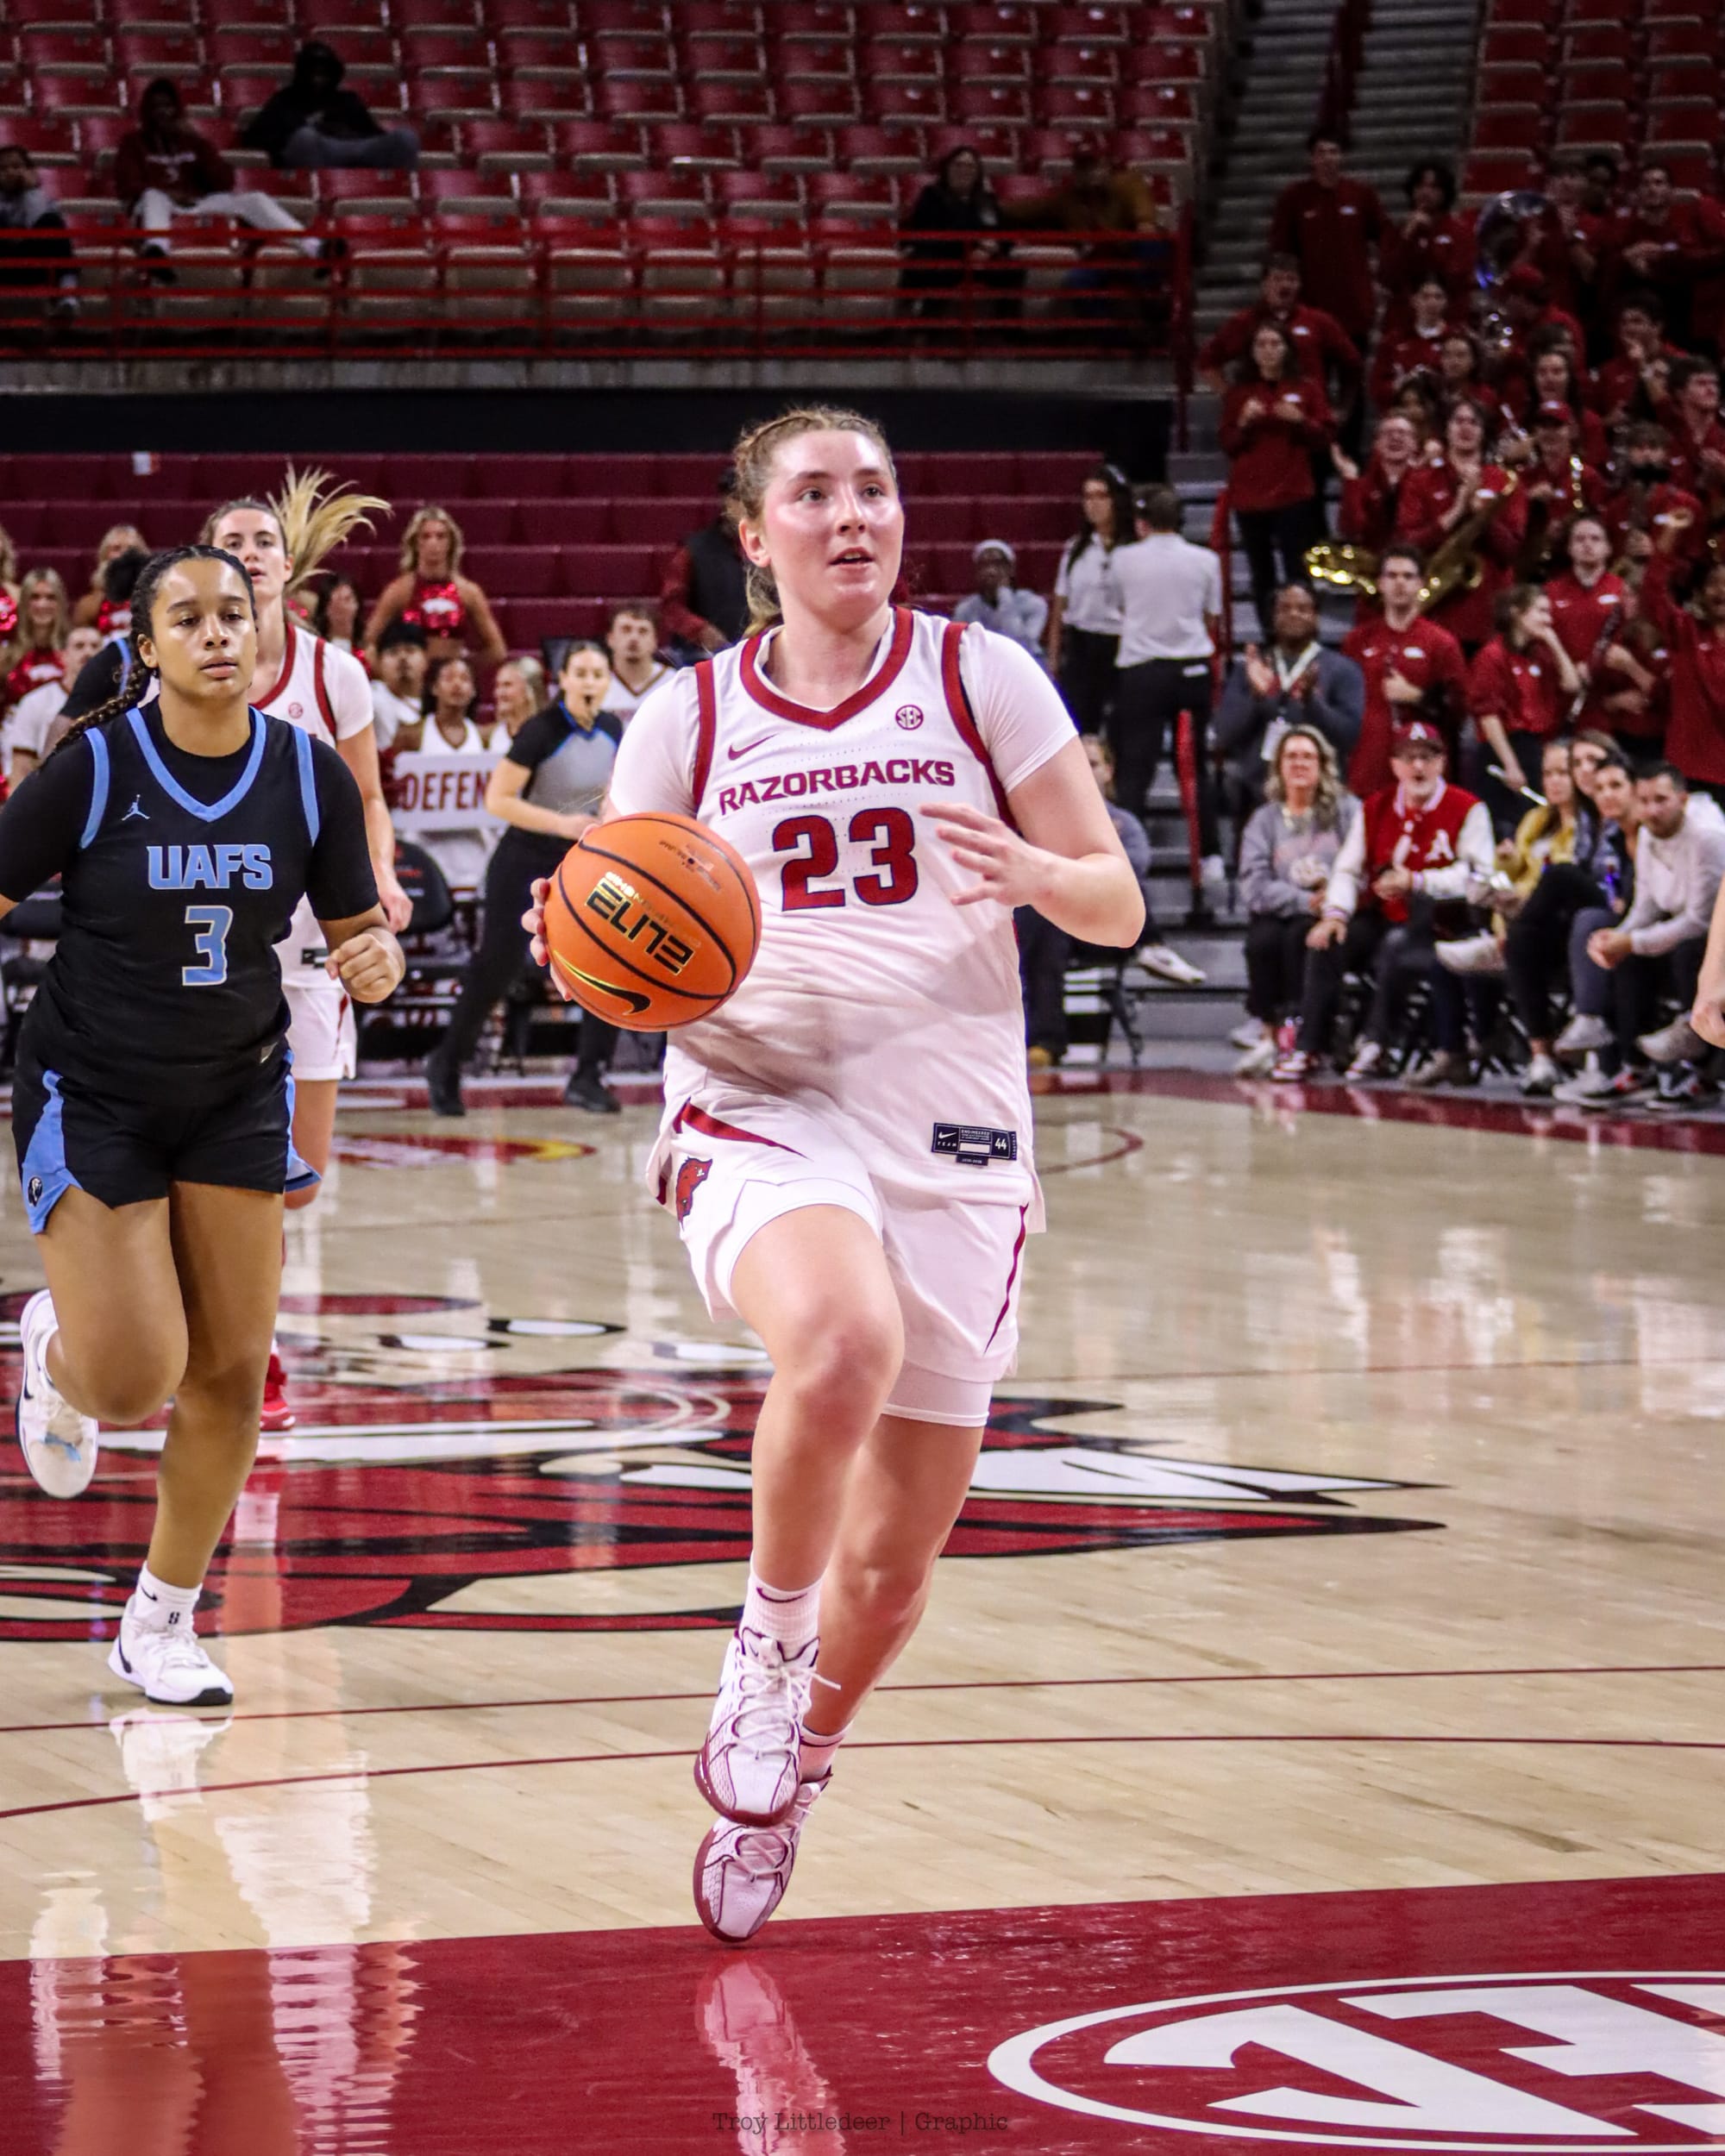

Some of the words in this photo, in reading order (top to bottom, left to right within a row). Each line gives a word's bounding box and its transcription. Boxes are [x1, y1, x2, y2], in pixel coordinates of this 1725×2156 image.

[895, 705, 923, 730] SEC
[1409, 722, 1427, 741] A
[718, 759, 955, 815] RAZORBACKS
[147, 844, 273, 890] UAFS
[772, 807, 919, 912] 23
[1425, 830, 1454, 861] A
[182, 906, 234, 986] 3
[584, 877, 696, 976] ELITE
[994, 1138, 1007, 1150] 44
[1104, 1984, 1725, 2136] EC
